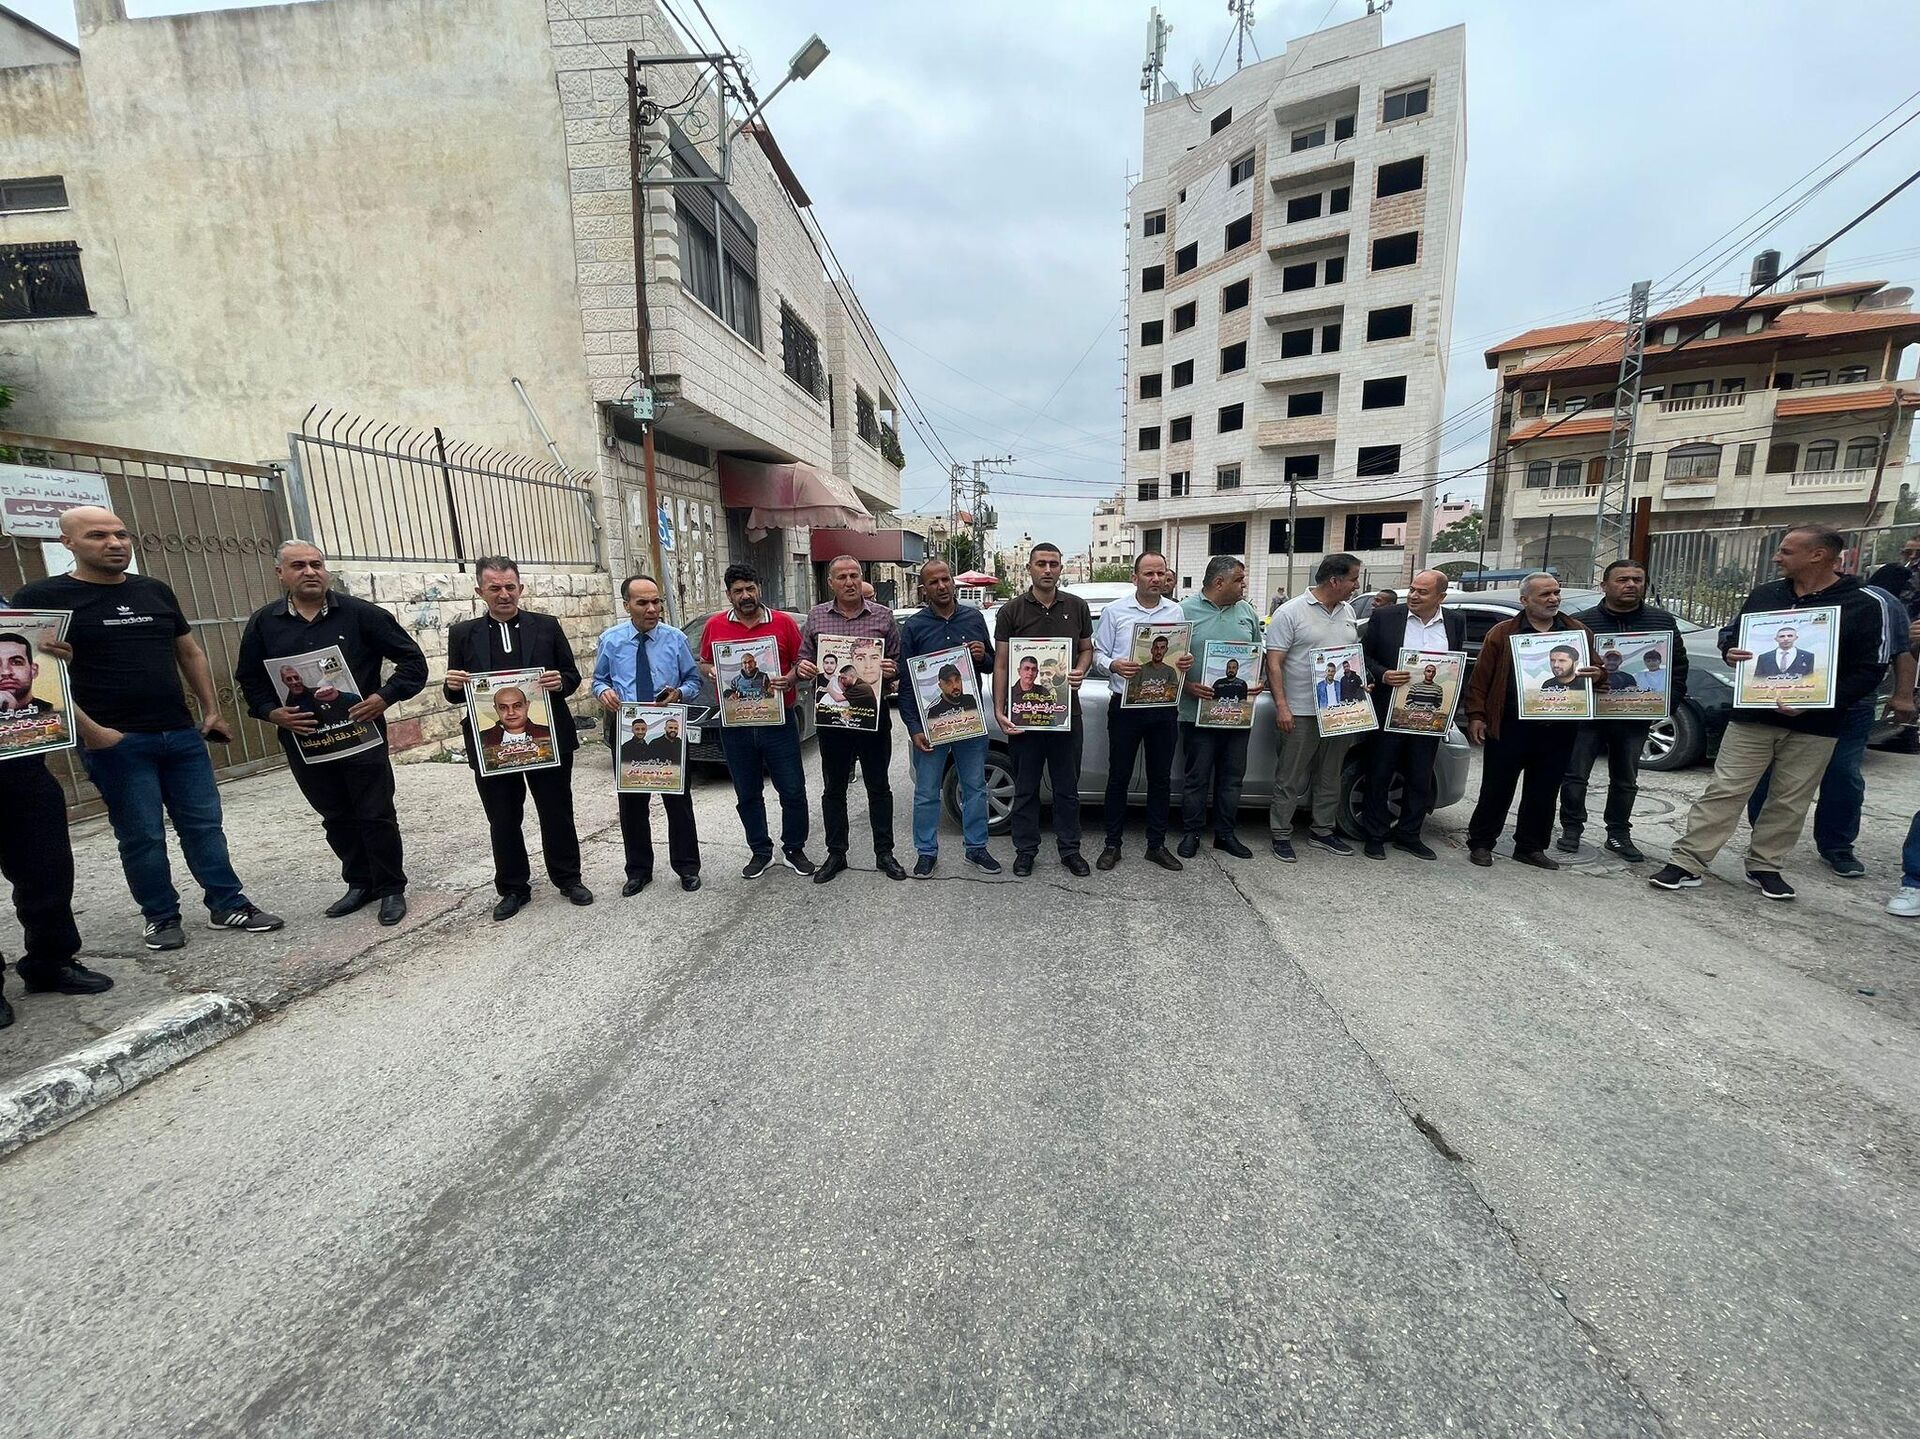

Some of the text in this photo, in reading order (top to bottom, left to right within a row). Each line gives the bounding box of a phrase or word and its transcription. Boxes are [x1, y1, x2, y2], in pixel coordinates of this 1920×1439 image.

[0, 485, 41, 497] الكراج
[67, 489, 105, 501] الوقوف
[121, 616, 154, 625] adidas
